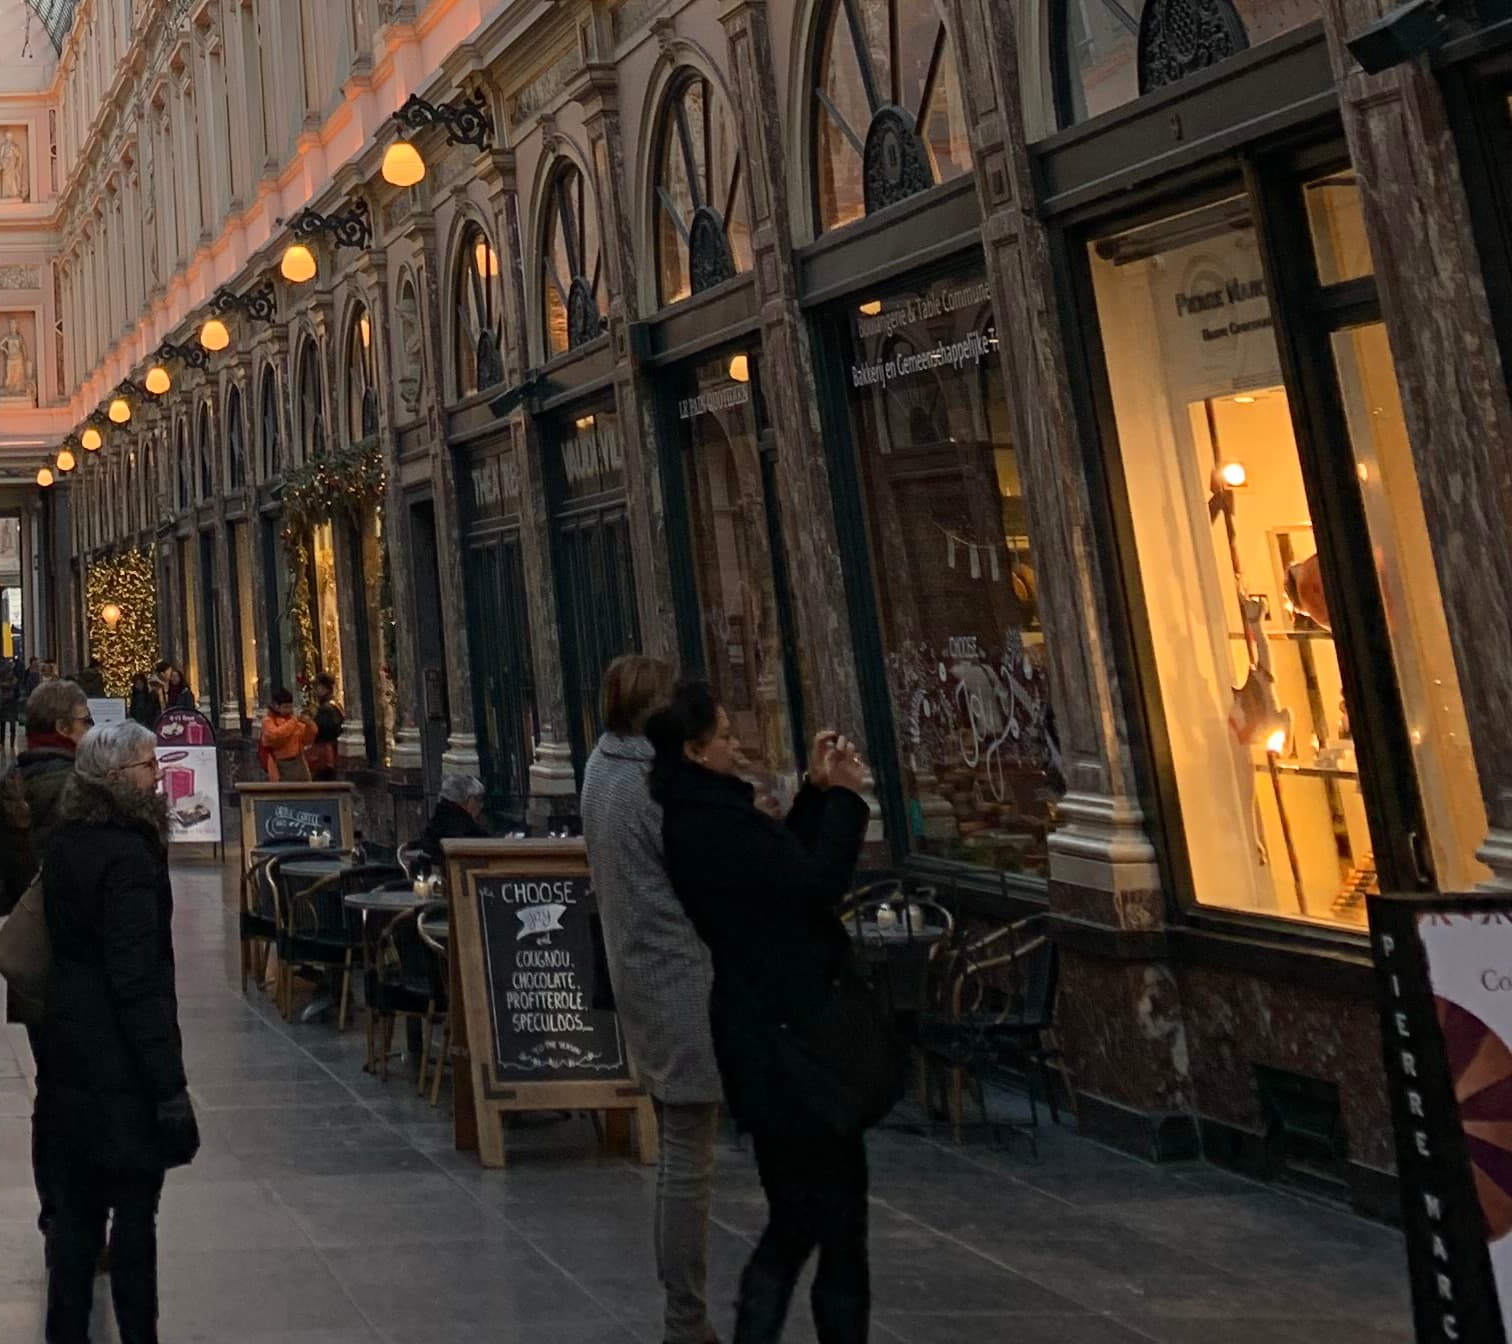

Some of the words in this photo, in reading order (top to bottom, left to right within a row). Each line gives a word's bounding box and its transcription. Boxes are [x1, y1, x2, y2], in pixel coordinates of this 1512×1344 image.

[907, 301, 917, 324] &
[916, 290, 942, 320] Table
[851, 358, 887, 388] Bakkerij
[887, 359, 897, 380] en
[896, 329, 990, 376] Gemeenschappelijke
[501, 881, 577, 905] CHOOSE
[1382, 933, 1432, 1158] PIERRE
